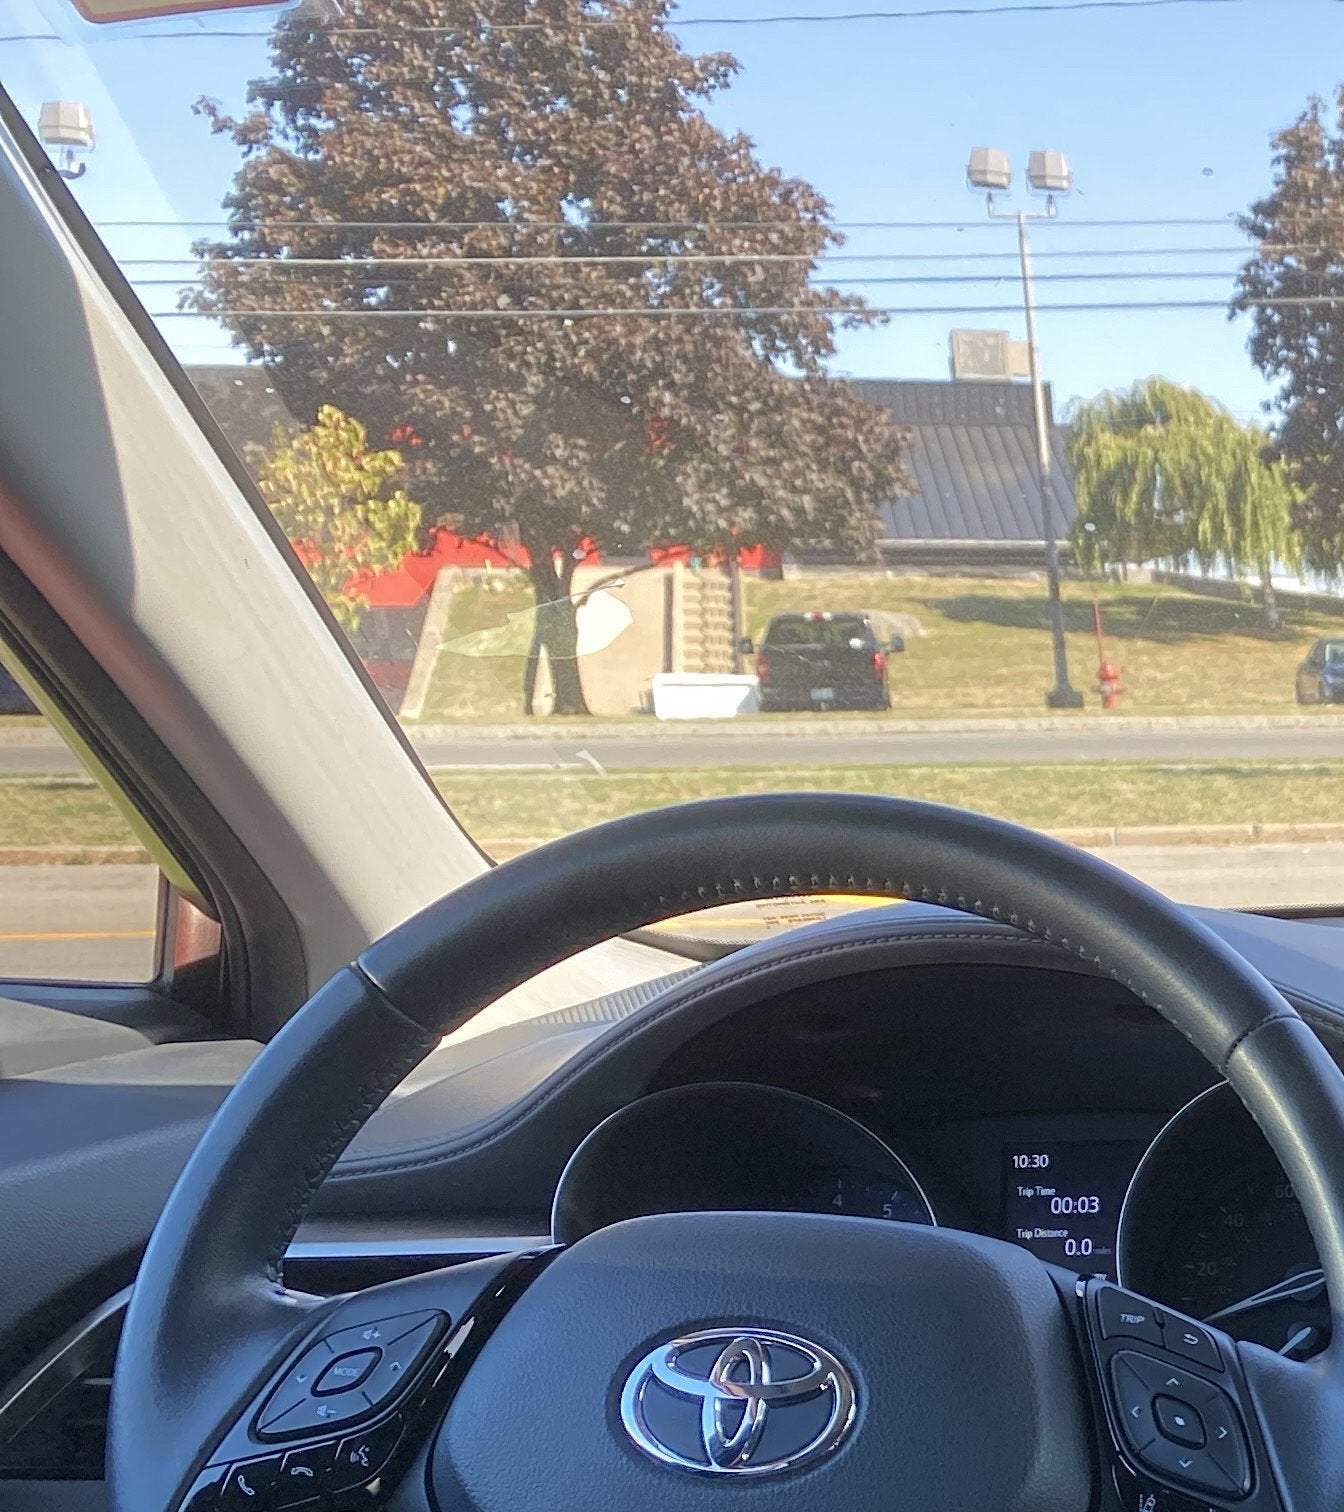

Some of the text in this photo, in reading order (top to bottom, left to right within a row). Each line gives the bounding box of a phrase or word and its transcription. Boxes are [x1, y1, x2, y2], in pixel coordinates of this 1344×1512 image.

[1012, 1154, 1049, 1169] 10:30
[1017, 1186, 1056, 1198] Trip Time
[882, 1203, 893, 1218] 5
[1050, 1196, 1100, 1214] 00:03
[1017, 1228, 1069, 1240] Trip Distance
[1065, 1238, 1092, 1256] 0.0
[1197, 1261, 1217, 1276] 20
[1120, 1313, 1145, 1324] TRIP
[334, 1367, 360, 1377] MODE
